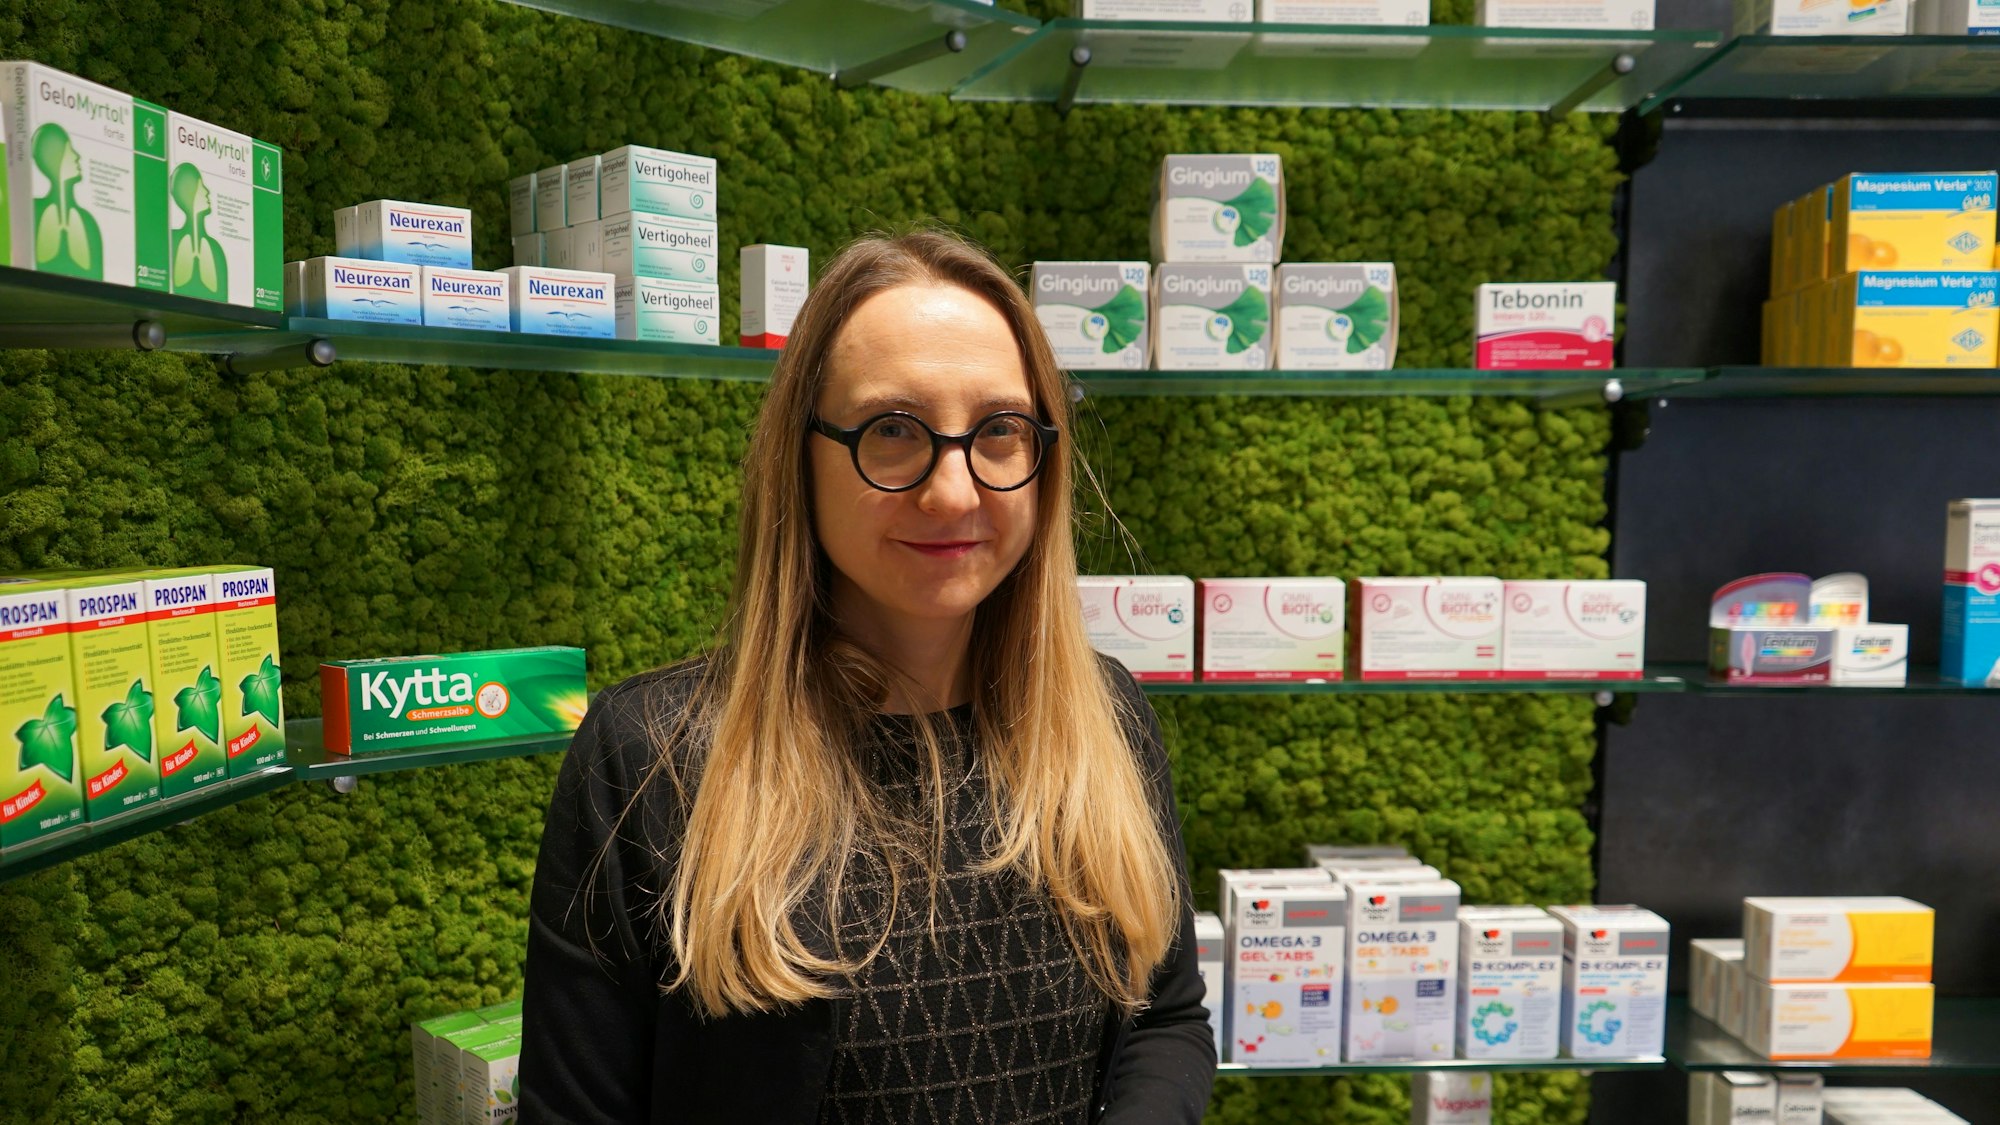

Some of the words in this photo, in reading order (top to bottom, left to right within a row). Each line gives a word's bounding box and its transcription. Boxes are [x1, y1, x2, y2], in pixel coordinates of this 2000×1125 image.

[103, 125, 125, 142] forte
[229, 163, 246, 177] forte
[1257, 160, 1276, 172] 120
[1170, 166, 1250, 189] Gingium
[1856, 179, 1931, 194] Magnesium
[1974, 180, 1992, 192] 300
[1125, 268, 1145, 280] 120
[1249, 269, 1268, 280] 120
[1863, 275, 1938, 290] Magnesium
[1979, 276, 1997, 288] 300
[256, 287, 265, 298] 20
[1039, 273, 1119, 296] Gingium
[1163, 274, 1243, 297] Gingium
[1284, 275, 1364, 297] Gingium
[1490, 288, 1583, 309] Tebonin
[155, 584, 207, 606] PROSPAN
[222, 577, 269, 598] PROSPAN
[79, 592, 137, 616] PROSPAN
[171, 607, 196, 616] Hustensaft
[237, 599, 259, 608] Hustensaft
[0, 601, 58, 626] ROSPAN
[1763, 634, 1818, 648] Centrum
[1854, 635, 1893, 647] Centrum
[412, 707, 469, 719] Schmerzsalbe
[364, 732, 374, 740] Bei
[376, 730, 415, 739] Schmerzen
[416, 727, 428, 735] und
[429, 723, 476, 735] Schwellungen
[231, 742, 240, 753] für
[240, 731, 257, 747] Kinder
[165, 761, 175, 772] für
[174, 747, 194, 766] Kinder
[91, 779, 102, 793] für
[102, 766, 124, 787] Kinder
[3, 803, 15, 817] für
[15, 788, 41, 810] Kinder
